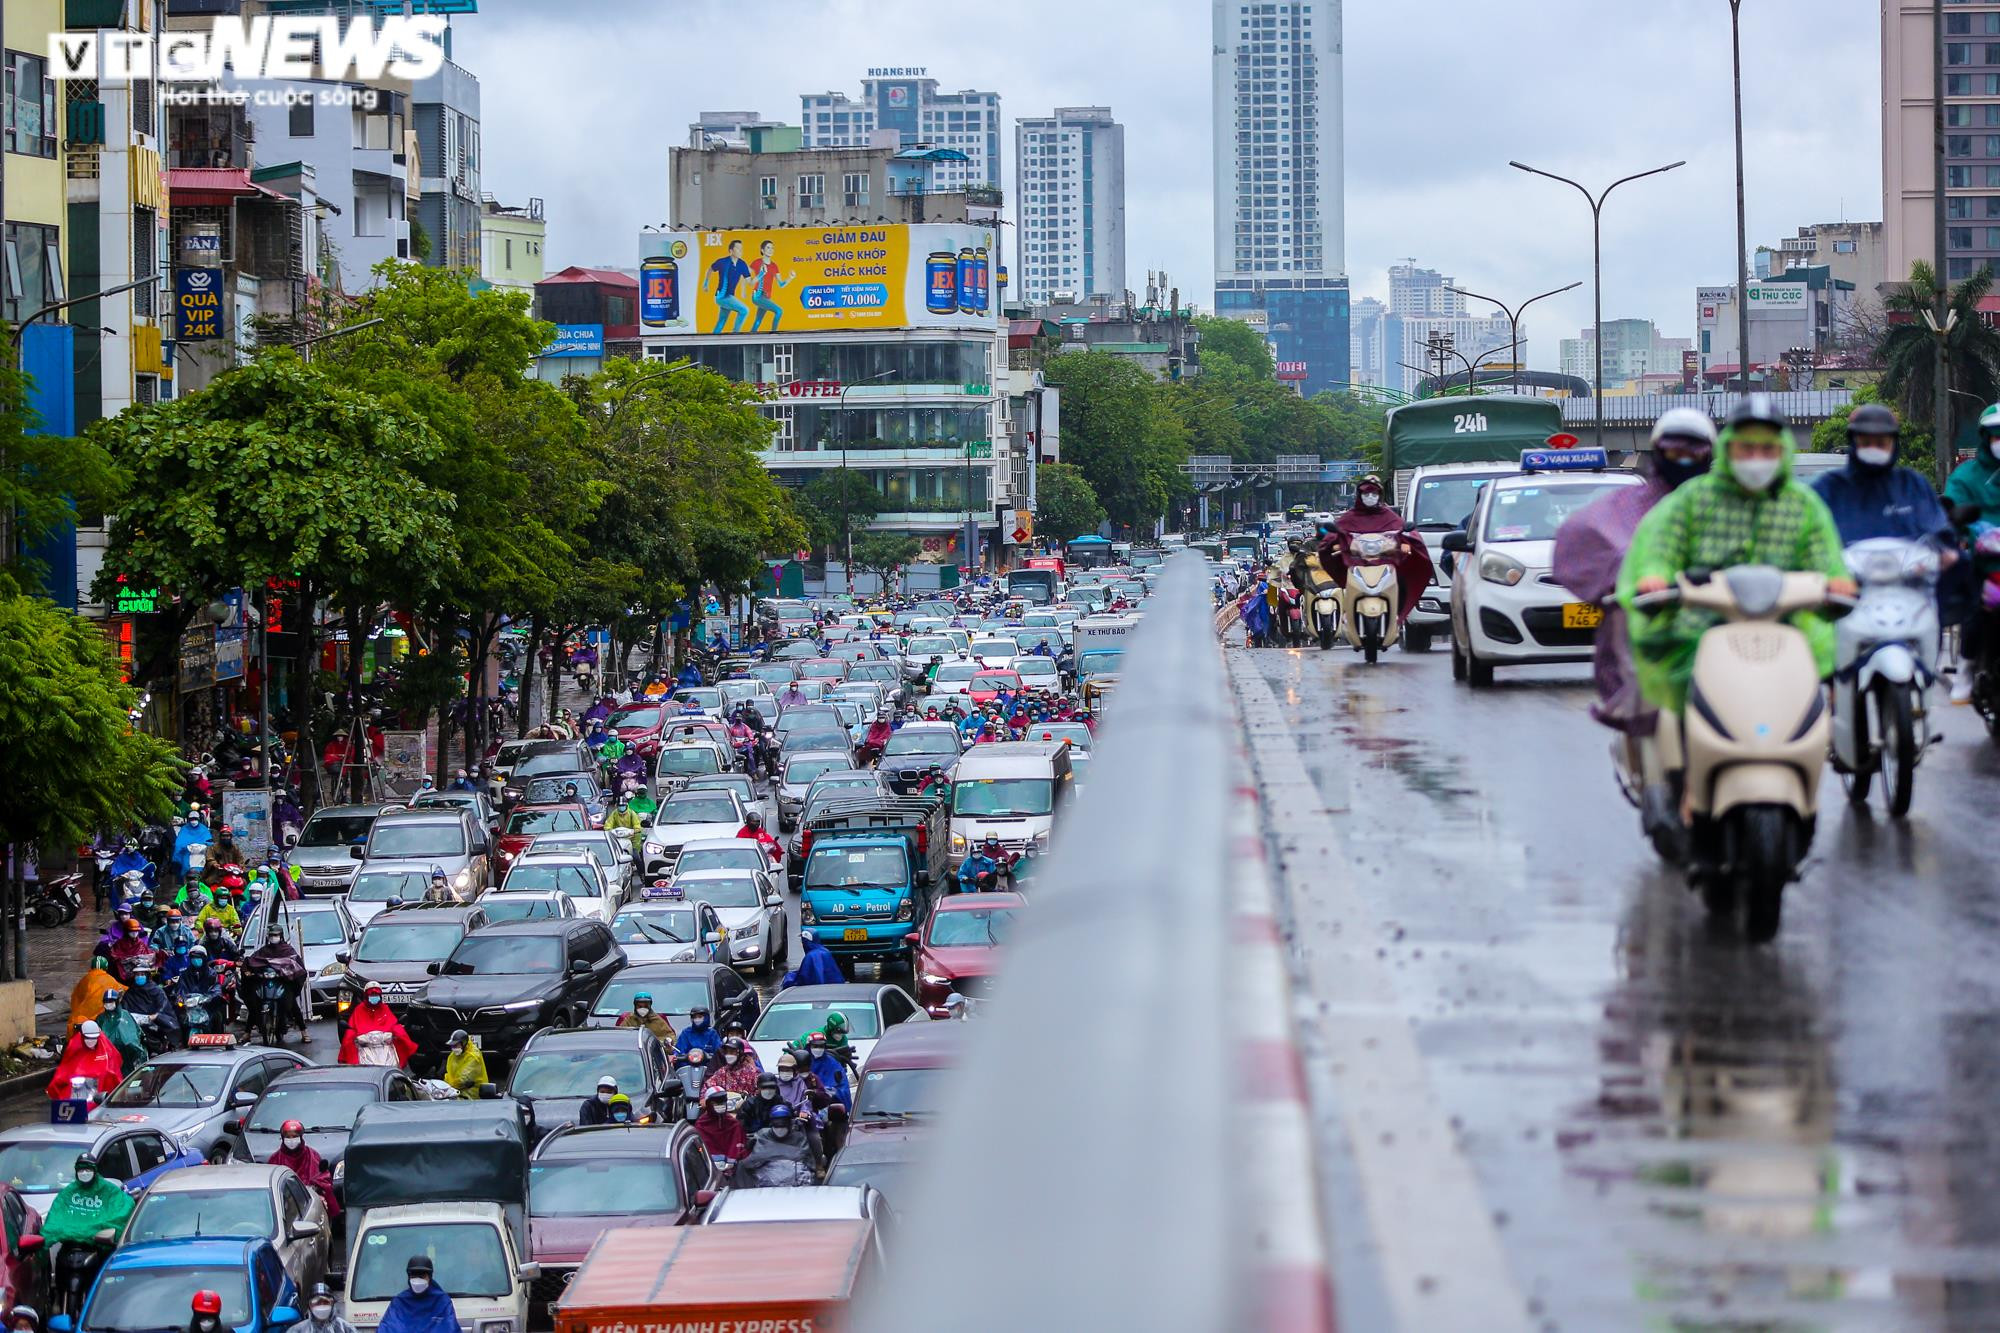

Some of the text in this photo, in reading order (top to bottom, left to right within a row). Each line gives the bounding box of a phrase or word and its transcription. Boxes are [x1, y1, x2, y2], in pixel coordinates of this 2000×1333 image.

[704, 233, 722, 247] JEX
[822, 229, 856, 244] GIẢM
[860, 231, 886, 242] ĐAU
[816, 250, 854, 261] XƯƠNG
[824, 263, 856, 277] CHẮC
[932, 271, 955, 289] JEX
[648, 279, 673, 298] JEX
[181, 291, 219, 308] QUÀ
[808, 296, 822, 307] 60
[1761, 292, 1779, 300] THU
[186, 309, 214, 322] VIP
[184, 323, 216, 336] 24K
[1454, 412, 1487, 433] 24h
[118, 597, 154, 612] CƯỚI
[1097, 628, 1110, 636] THƯ
[832, 903, 845, 913] AD
[866, 902, 891, 912] Petrol
[191, 1034, 229, 1044] Taxi 123
[72, 1193, 103, 1208] Grab
[722, 1319, 812, 1333] EXPRESS
